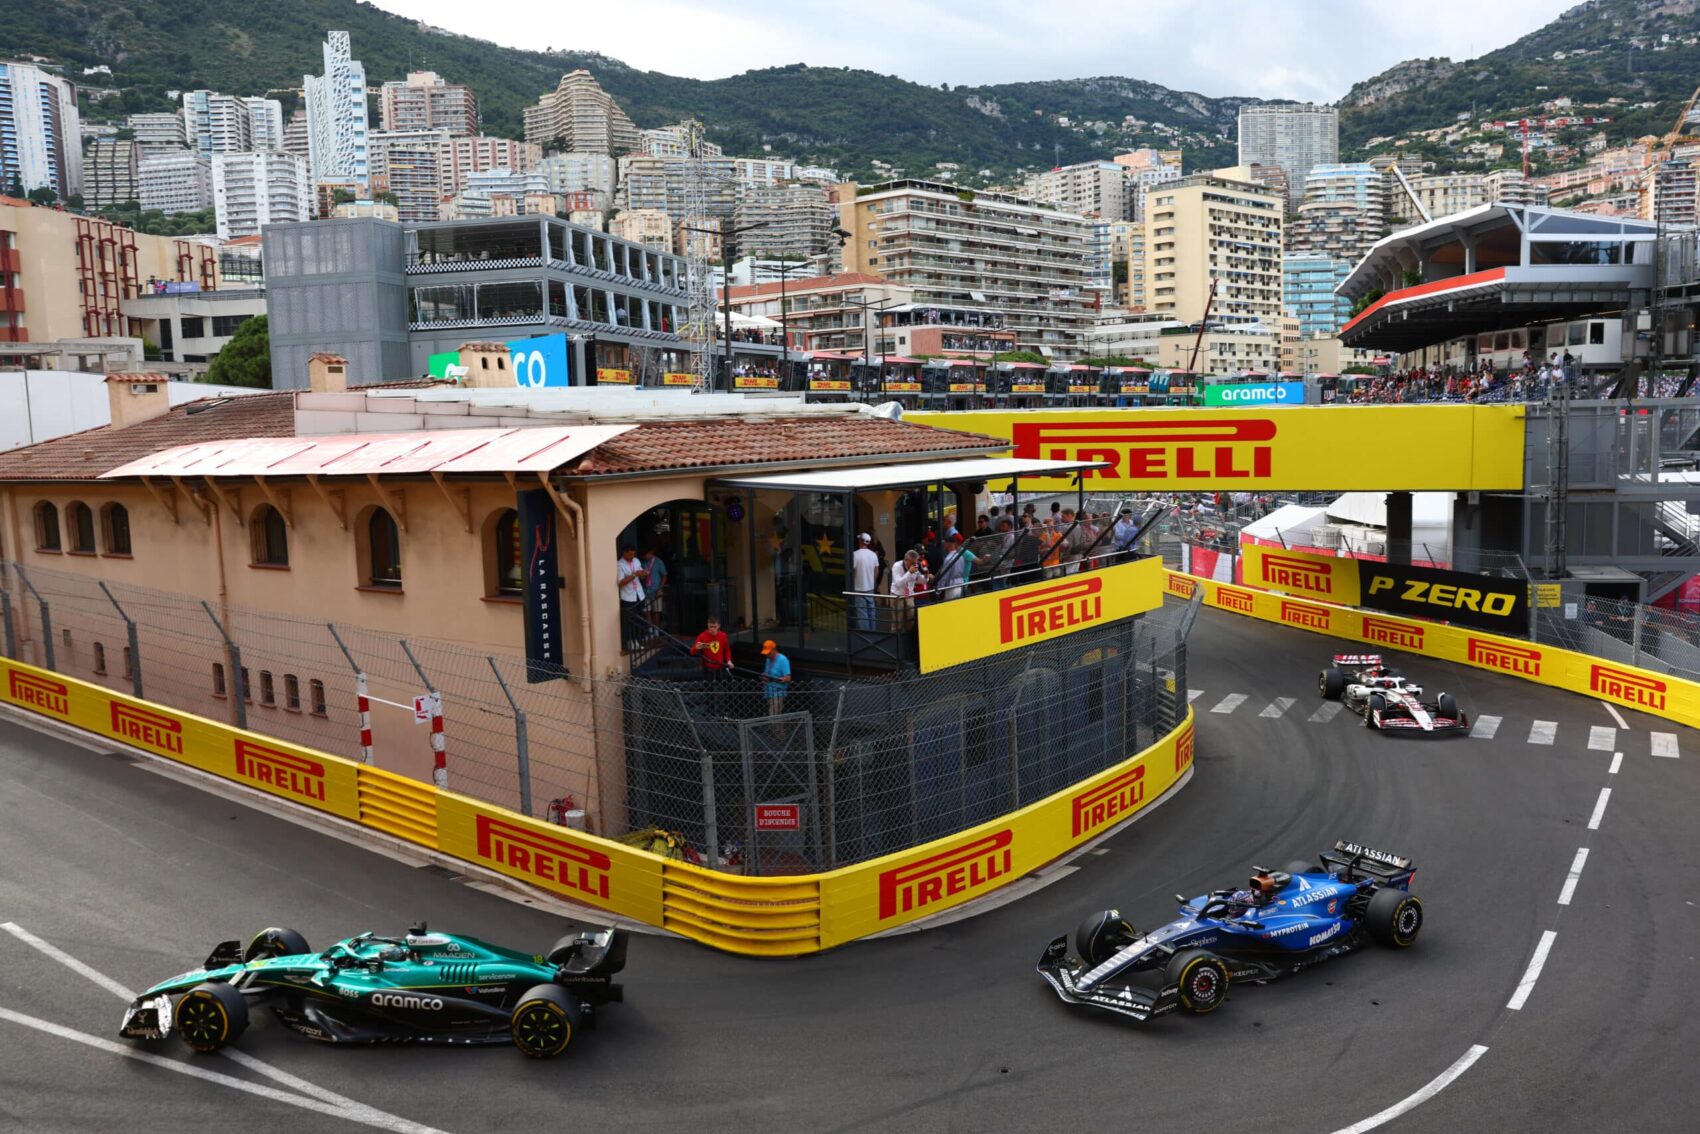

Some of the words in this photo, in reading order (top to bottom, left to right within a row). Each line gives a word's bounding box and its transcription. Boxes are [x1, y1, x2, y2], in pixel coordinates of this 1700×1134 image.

[1221, 387, 1287, 400] aramco
[1013, 419, 1277, 478] PIRELLI
[1262, 553, 1332, 594] PIRELLI
[1000, 577, 1102, 644] PIRELLI
[1217, 587, 1254, 613] PIRELLI
[1281, 601, 1331, 630] PIRELLI
[1368, 576, 1394, 595] P
[1401, 580, 1516, 616] ZERO
[1362, 617, 1425, 651] PIRELLI
[1468, 638, 1542, 677] PIRELLI
[9, 669, 69, 716] PIRELLI
[1590, 665, 1667, 710] PIRELLI
[110, 700, 183, 754] PIRELLI
[234, 739, 325, 801] PIRELLI
[1072, 764, 1146, 838] PIRELLI
[476, 814, 610, 901] PIRELLI
[879, 829, 1013, 921] PIRELLI
[1292, 887, 1338, 909] ATLASSIAN
[1270, 922, 1309, 938] MYPROTEIN
[339, 988, 359, 998] BOSS
[371, 993, 444, 1011] aramco
